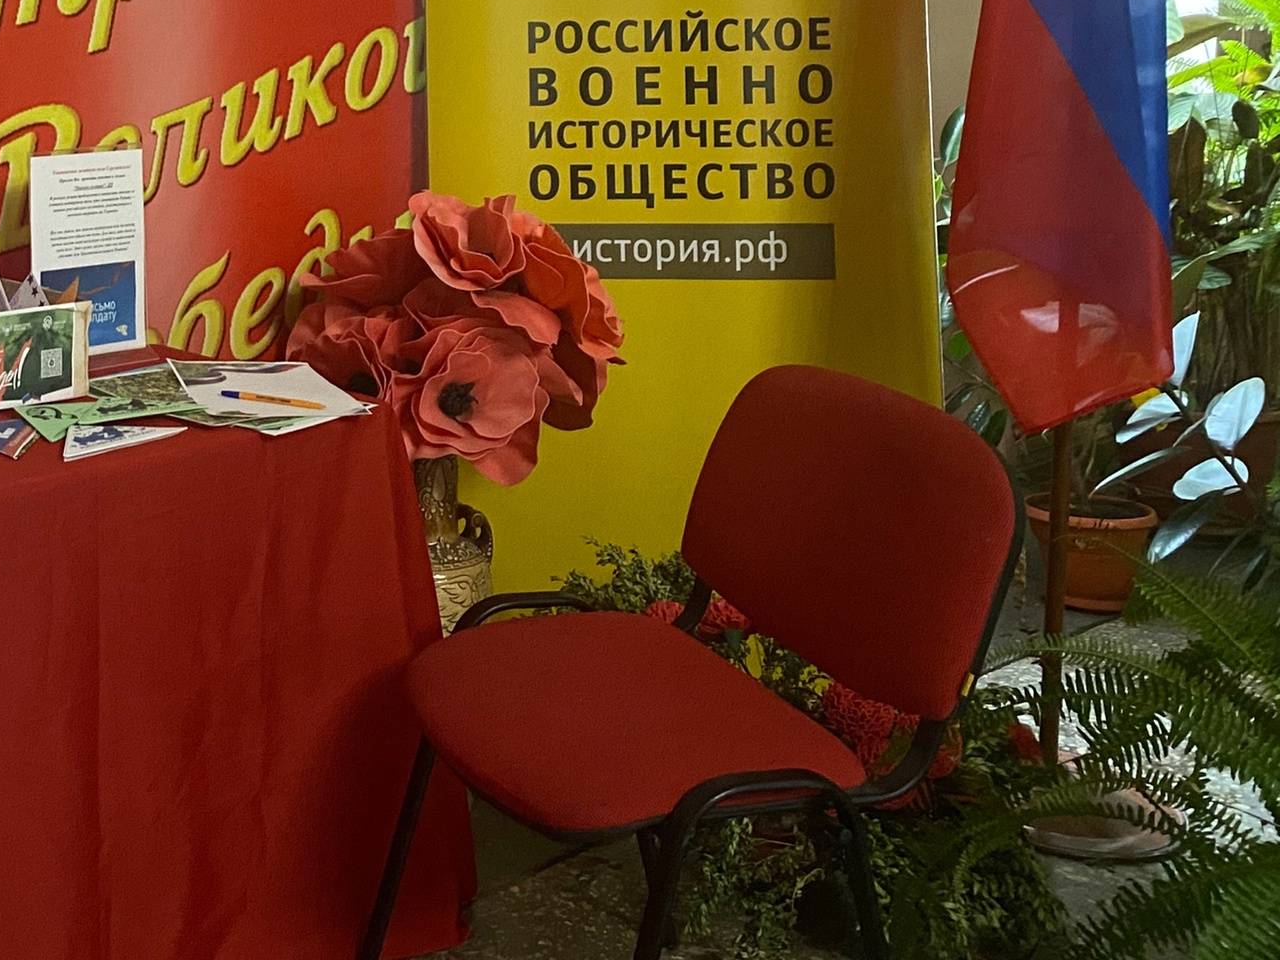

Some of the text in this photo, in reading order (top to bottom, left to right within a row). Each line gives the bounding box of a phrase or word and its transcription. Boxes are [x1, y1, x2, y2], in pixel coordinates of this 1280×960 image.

[527, 9, 831, 54] РОССИЙСКОЕ
[528, 64, 833, 106] ВОЕННО
[528, 118, 833, 149] ИСТОРИЧЕСКОЕ
[529, 162, 835, 209] ОБЩЕСТВО
[573, 230, 788, 271] история.рф
[91, 300, 117, 311] сьмо
[92, 311, 117, 323] лдату
